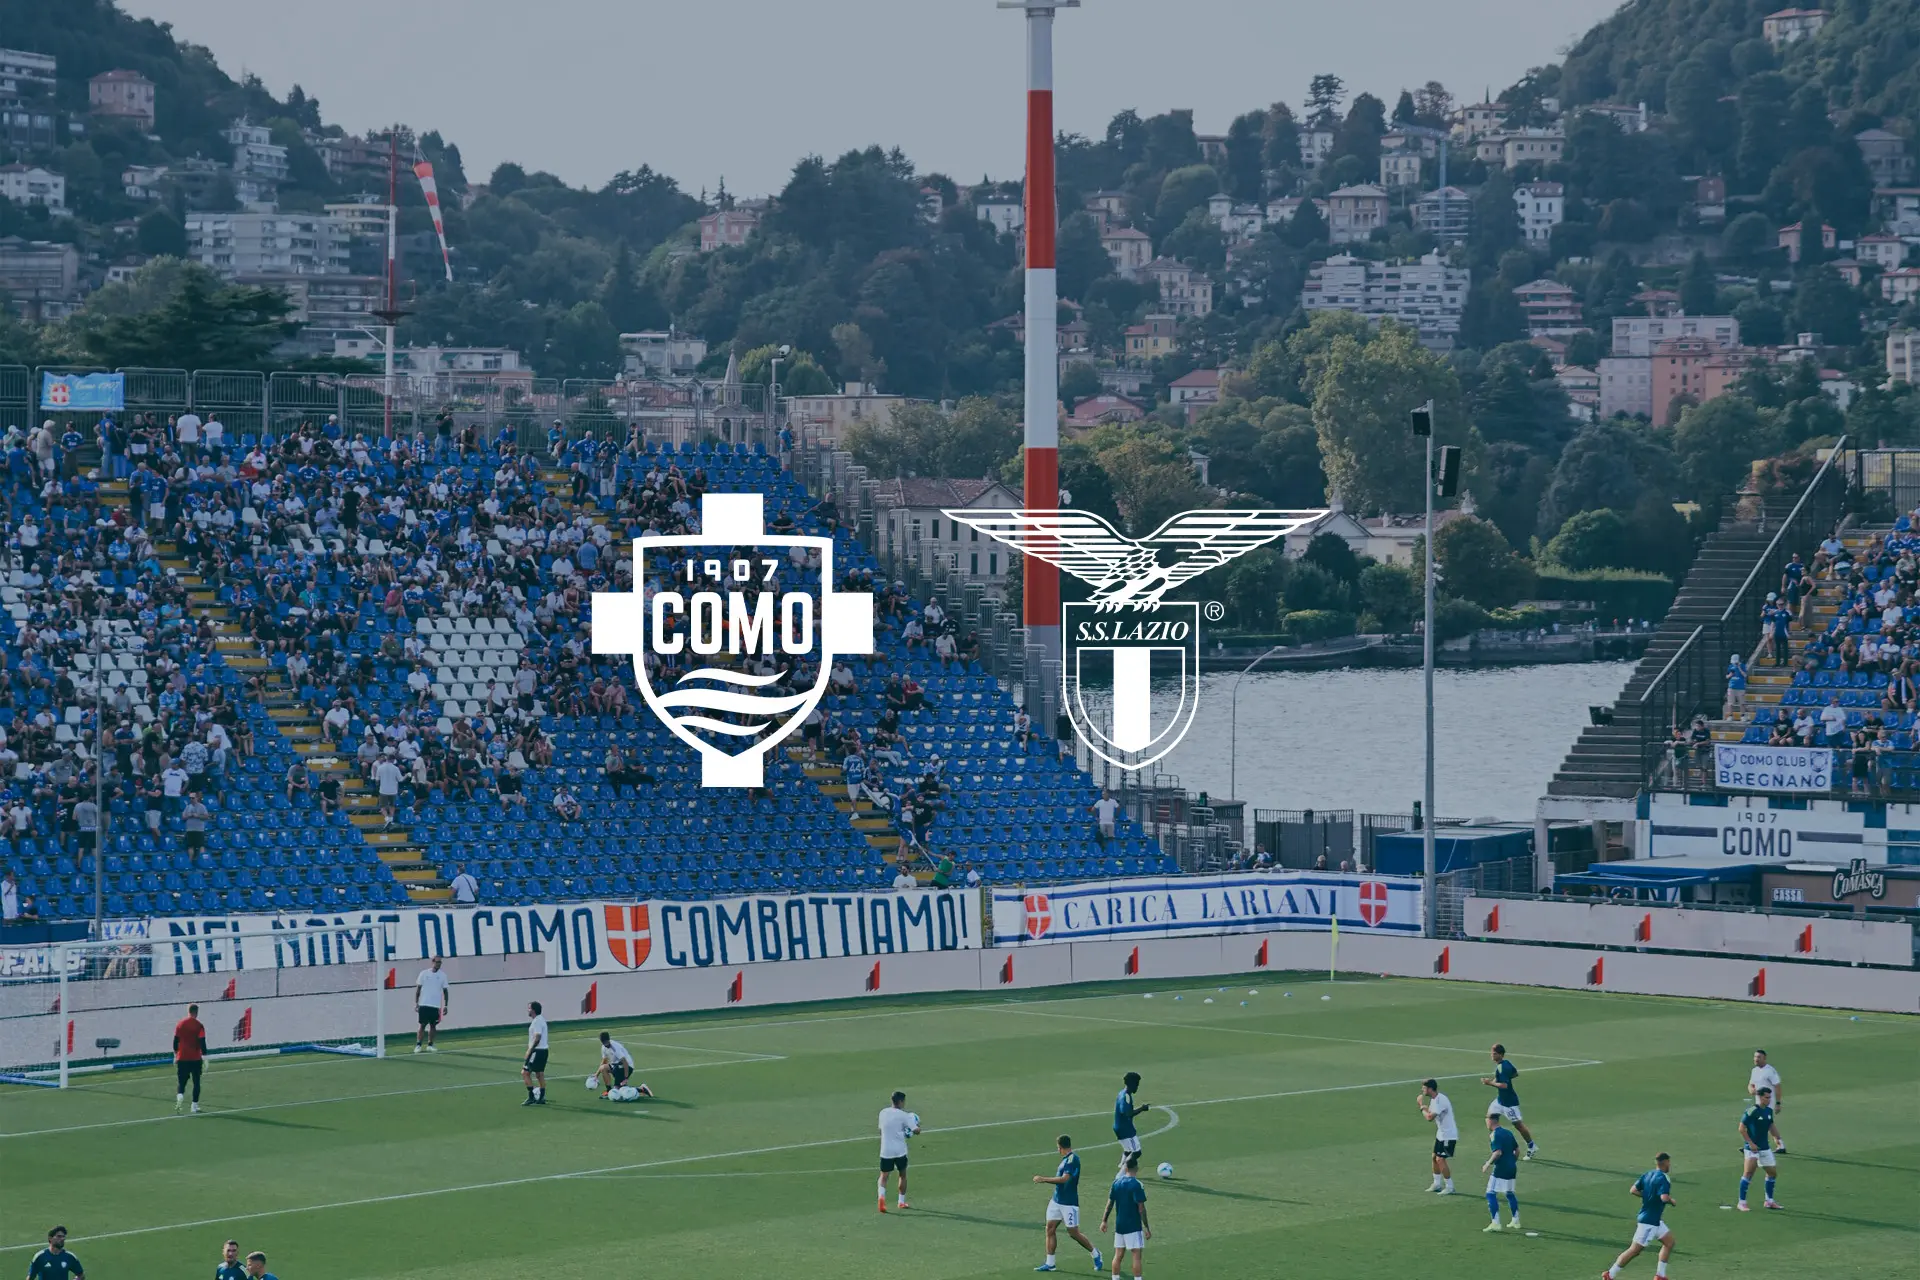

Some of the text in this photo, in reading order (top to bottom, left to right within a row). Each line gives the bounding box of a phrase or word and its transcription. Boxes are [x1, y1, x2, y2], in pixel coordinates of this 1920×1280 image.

[1739, 753, 1807, 768] COMO CLUB
[1719, 770, 1827, 788] BREGNANO
[1737, 812, 1778, 824] 1907
[1722, 826, 1792, 857] COMO
[1851, 859, 1867, 876] LA
[1772, 888, 1803, 902] CASSA
[1063, 887, 1338, 931] CARICA LARIANI
[271, 914, 400, 969] NOME
[472, 906, 598, 971] COMO
[661, 893, 970, 967] COMBATTIAMO!
